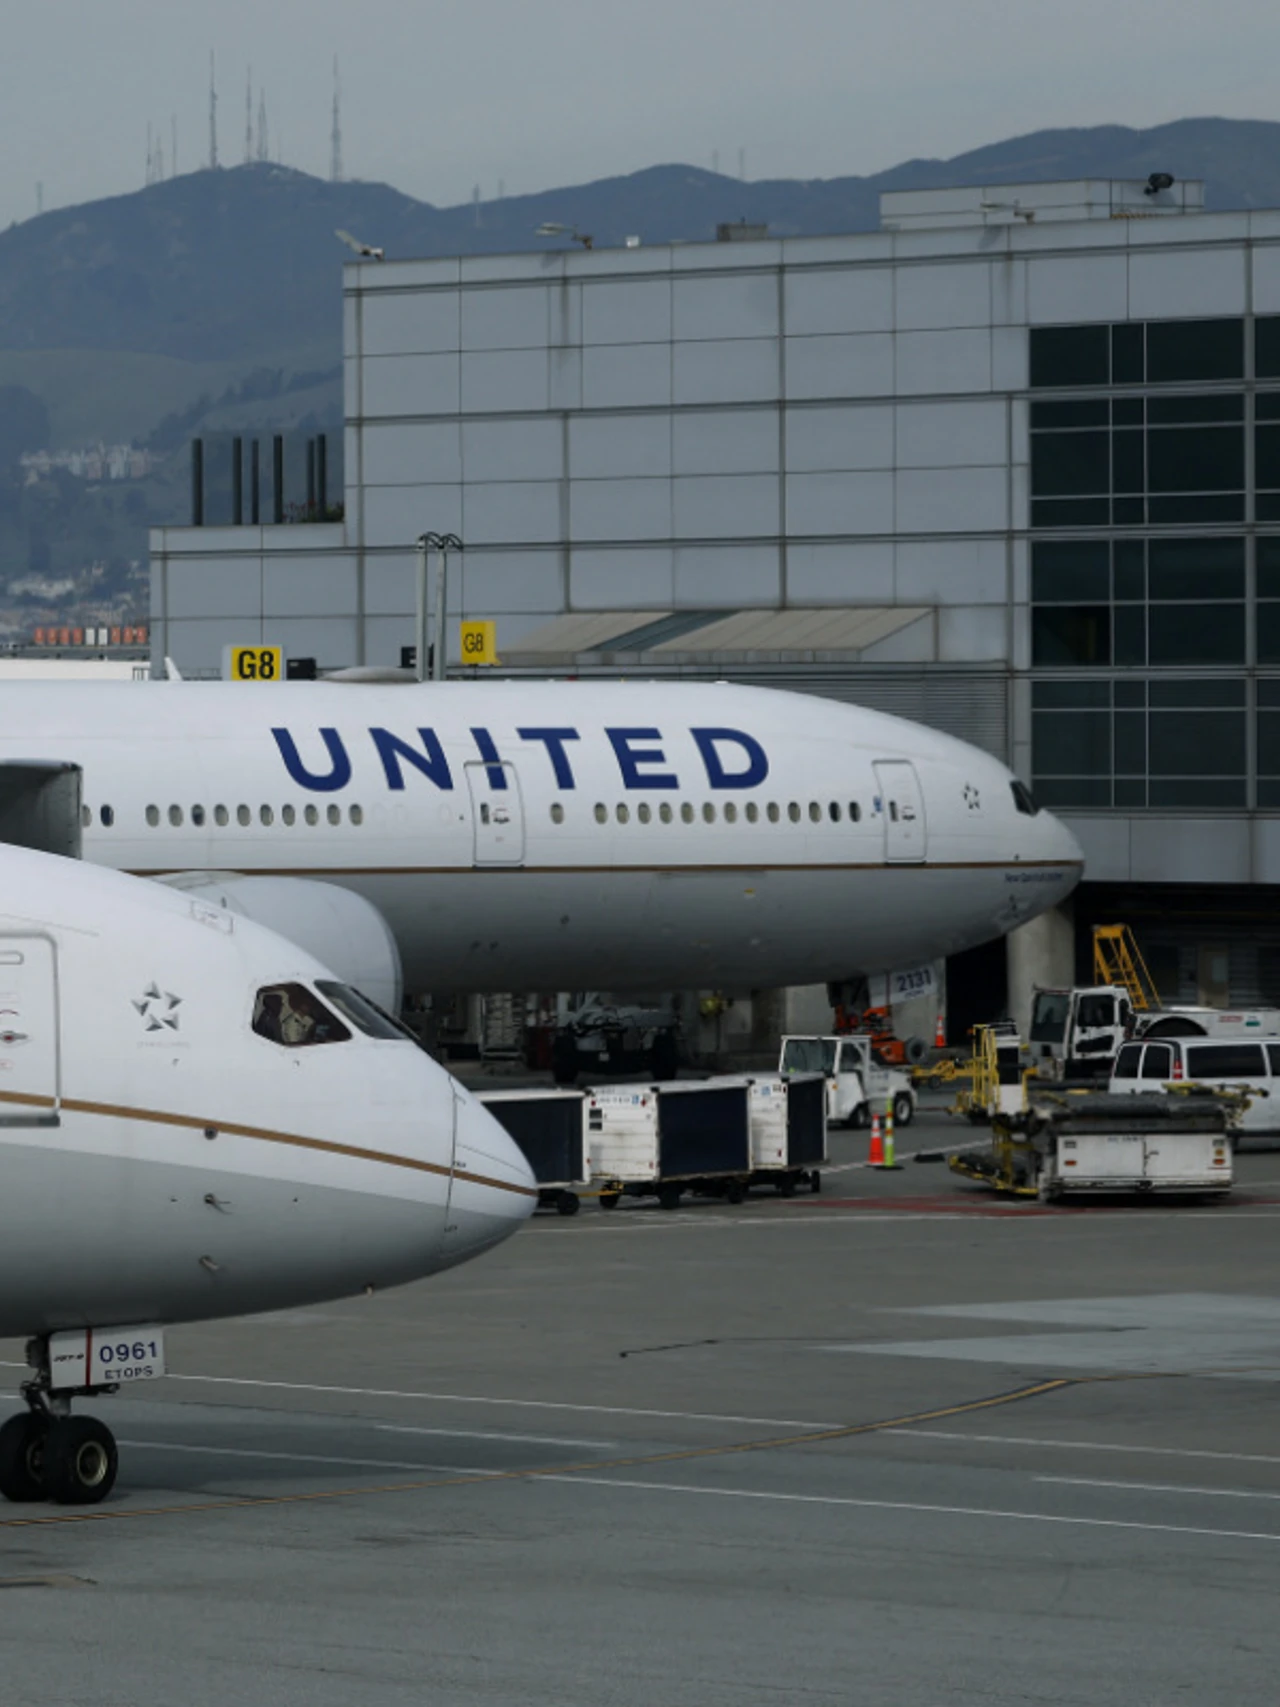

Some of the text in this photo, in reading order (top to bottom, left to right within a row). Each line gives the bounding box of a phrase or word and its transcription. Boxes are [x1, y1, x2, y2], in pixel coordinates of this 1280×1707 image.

[463, 632, 484, 653] G8
[238, 650, 275, 680] G8
[271, 727, 768, 792] UNITED
[897, 968, 932, 992] 2131
[99, 1340, 158, 1364] 0961
[104, 1365, 154, 1380] ETOPS
